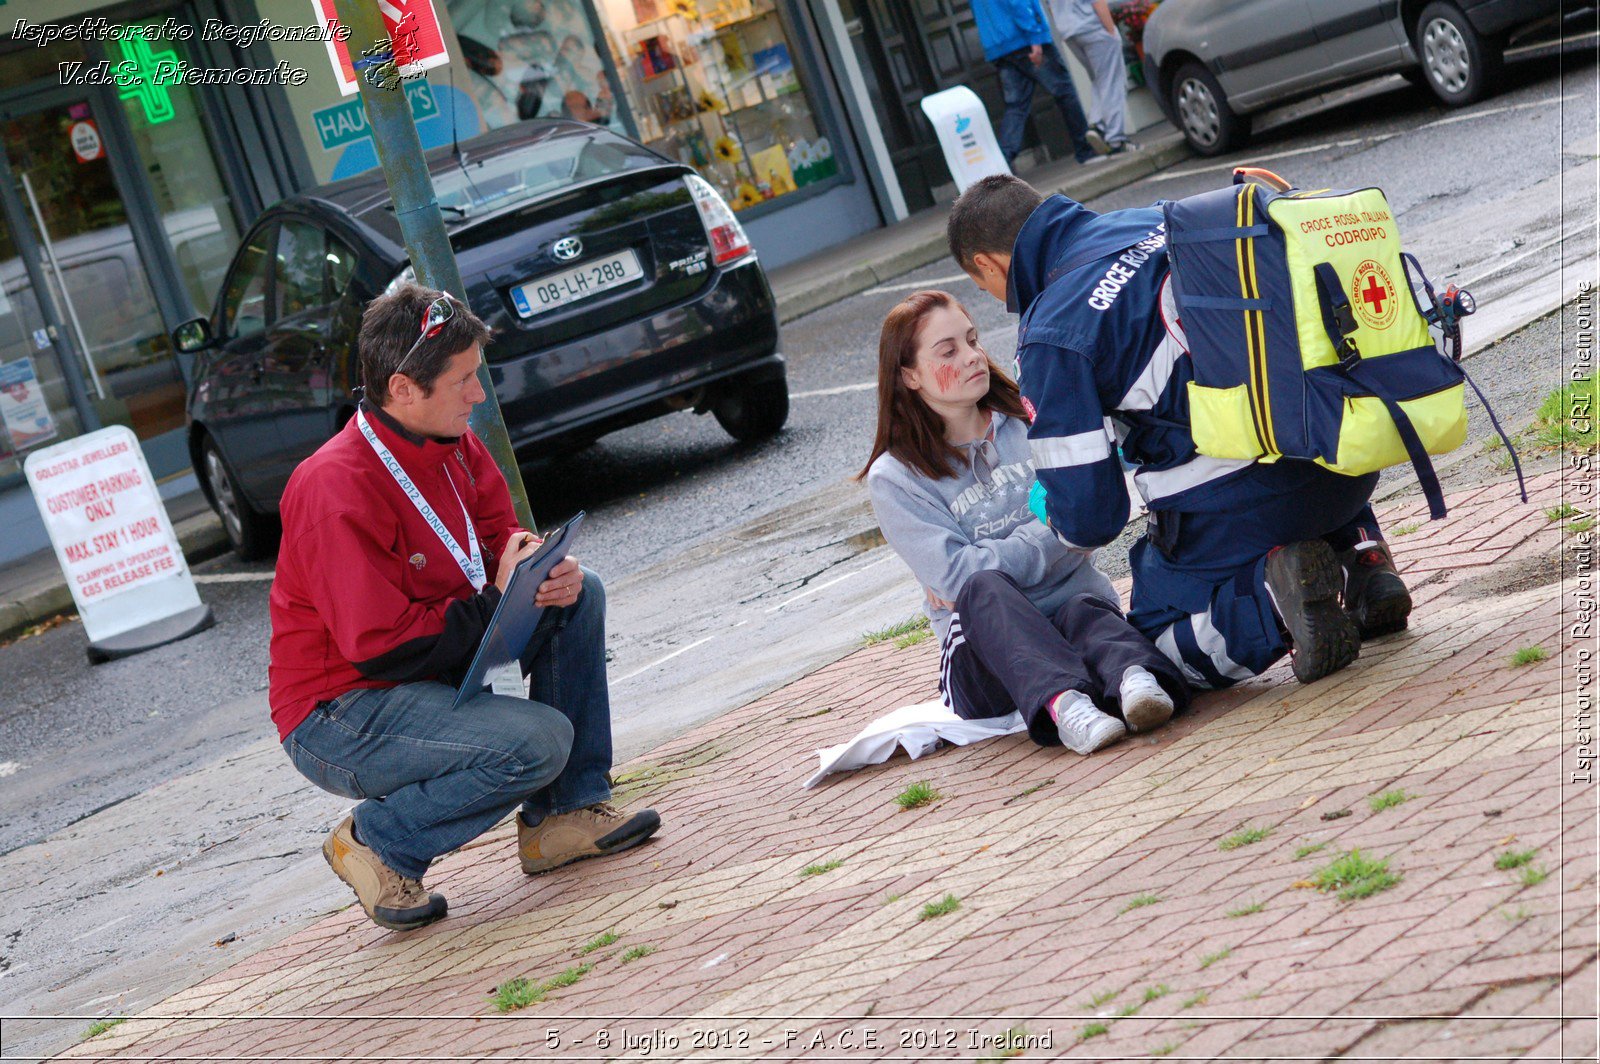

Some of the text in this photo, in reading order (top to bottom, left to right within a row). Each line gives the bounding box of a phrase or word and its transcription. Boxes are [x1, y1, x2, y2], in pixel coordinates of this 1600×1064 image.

[317, 84, 433, 142] HAUY'S
[1299, 210, 1390, 234] CROCE ROSSA ITALIANA
[1325, 226, 1387, 248] CODROIPO
[537, 259, 626, 304] 08-LH-288
[1087, 262, 1137, 311] CROCE
[35, 441, 129, 481] GOLDSTAR JEWELLERS
[46, 468, 142, 514] CUSTOMER PARKING
[84, 497, 116, 522] ONLY
[379, 449, 402, 477] FACE
[399, 476, 419, 500] 2012
[420, 505, 459, 553] DUNDALK
[93, 529, 120, 554] STAY
[120, 528, 129, 544] 1
[128, 516, 162, 541] HOUR
[76, 544, 170, 584] CLAMPING IN OPERATION
[103, 565, 152, 591] RELEASE
[153, 556, 175, 572] FEE
